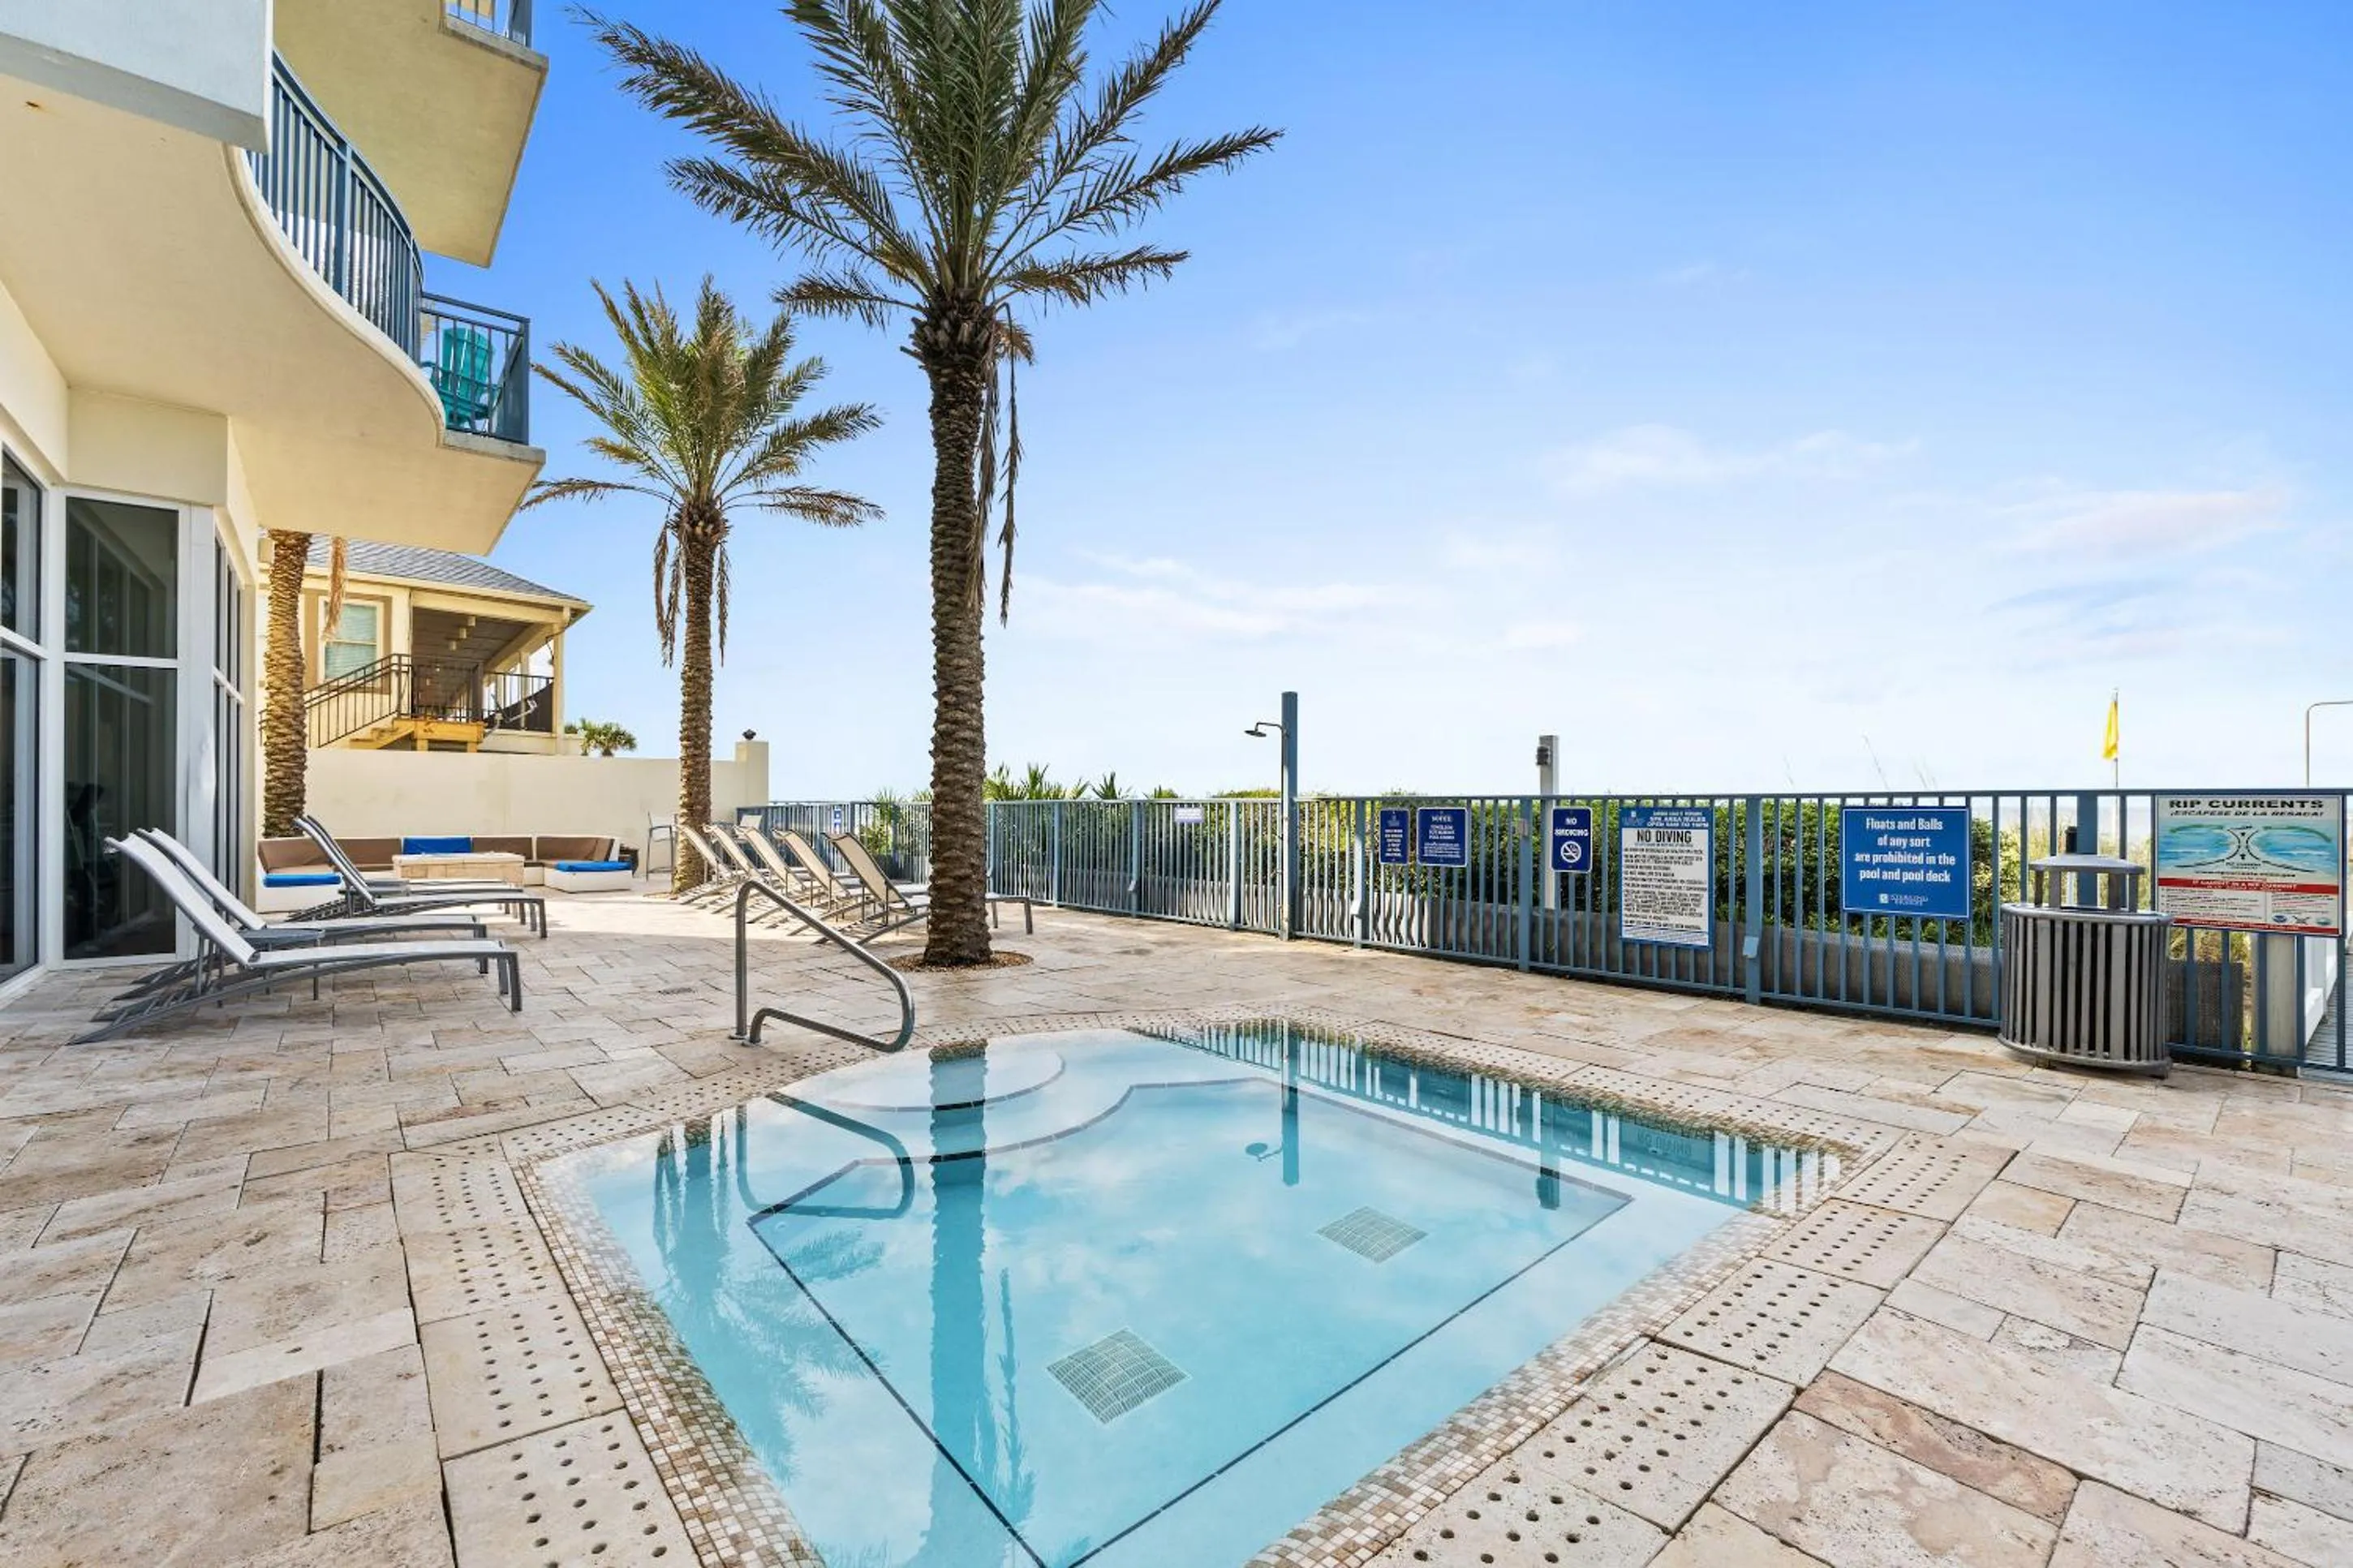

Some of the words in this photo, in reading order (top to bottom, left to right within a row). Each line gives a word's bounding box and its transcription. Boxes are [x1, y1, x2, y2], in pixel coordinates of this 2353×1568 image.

[2169, 800, 2201, 808] RIP
[2208, 800, 2324, 808] CURRENTS
[1866, 818, 1895, 830] Floats
[1897, 818, 1916, 831] and
[1917, 818, 1943, 831] Balls
[1554, 828, 1589, 836] SMOKING
[1637, 830, 1651, 843] NO
[1655, 831, 1692, 844] DIVING
[1878, 834, 1888, 846] of
[1890, 837, 1908, 848] any
[1909, 836, 1931, 848] sort
[1855, 853, 1870, 862] are
[1872, 852, 1924, 866] prohibited
[1925, 853, 1936, 865] in
[1938, 853, 1955, 866] the
[1860, 868, 1880, 881] pool
[1882, 868, 1900, 881] and
[1902, 870, 1924, 883] pool
[1925, 870, 1951, 883] deck
